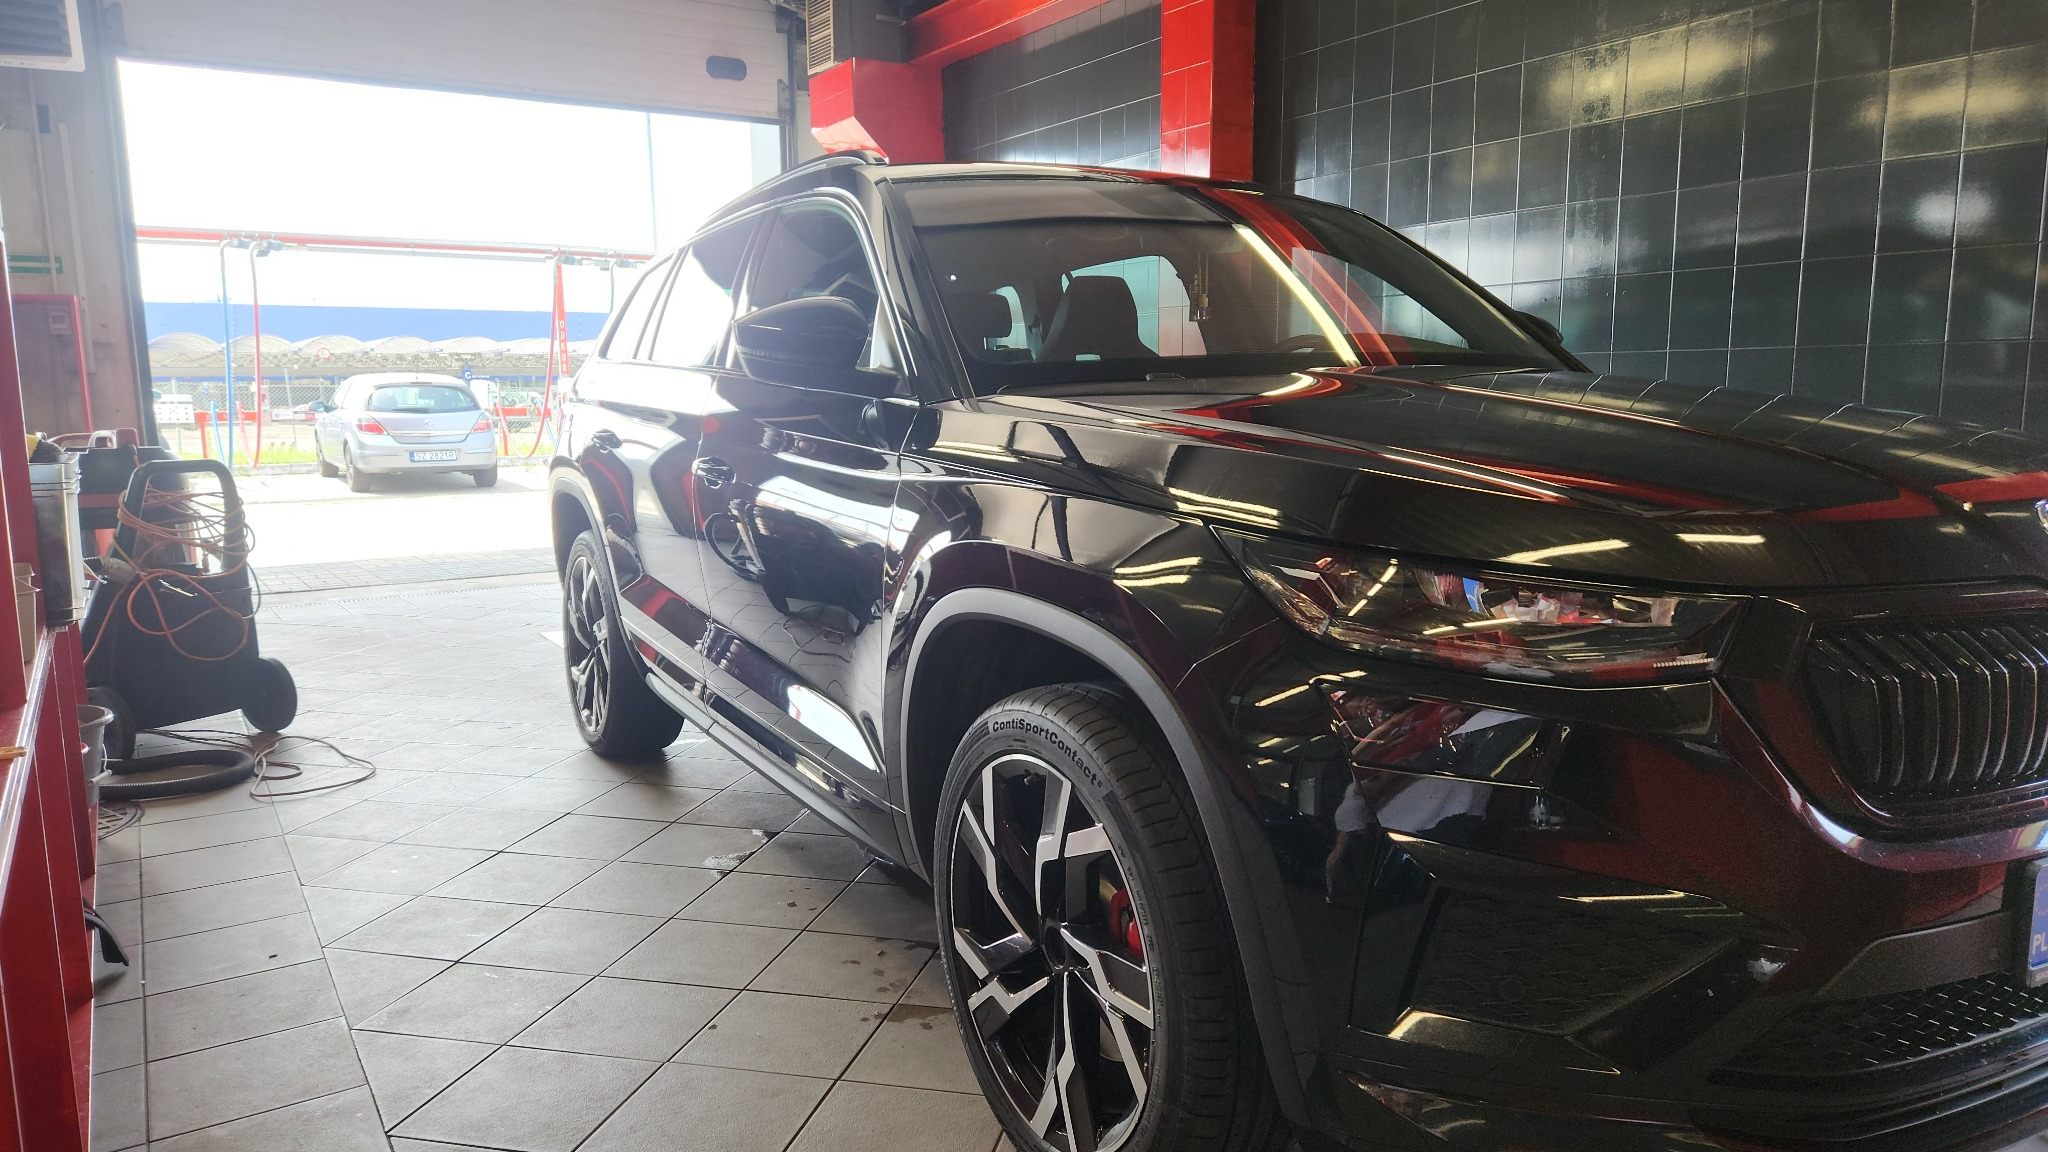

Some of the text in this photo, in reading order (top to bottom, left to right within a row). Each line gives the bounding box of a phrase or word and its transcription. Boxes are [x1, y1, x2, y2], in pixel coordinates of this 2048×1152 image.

[415, 452, 427, 460] SZ
[992, 718, 1099, 786] ContiSportContact
[2032, 932, 2048, 954] PL
